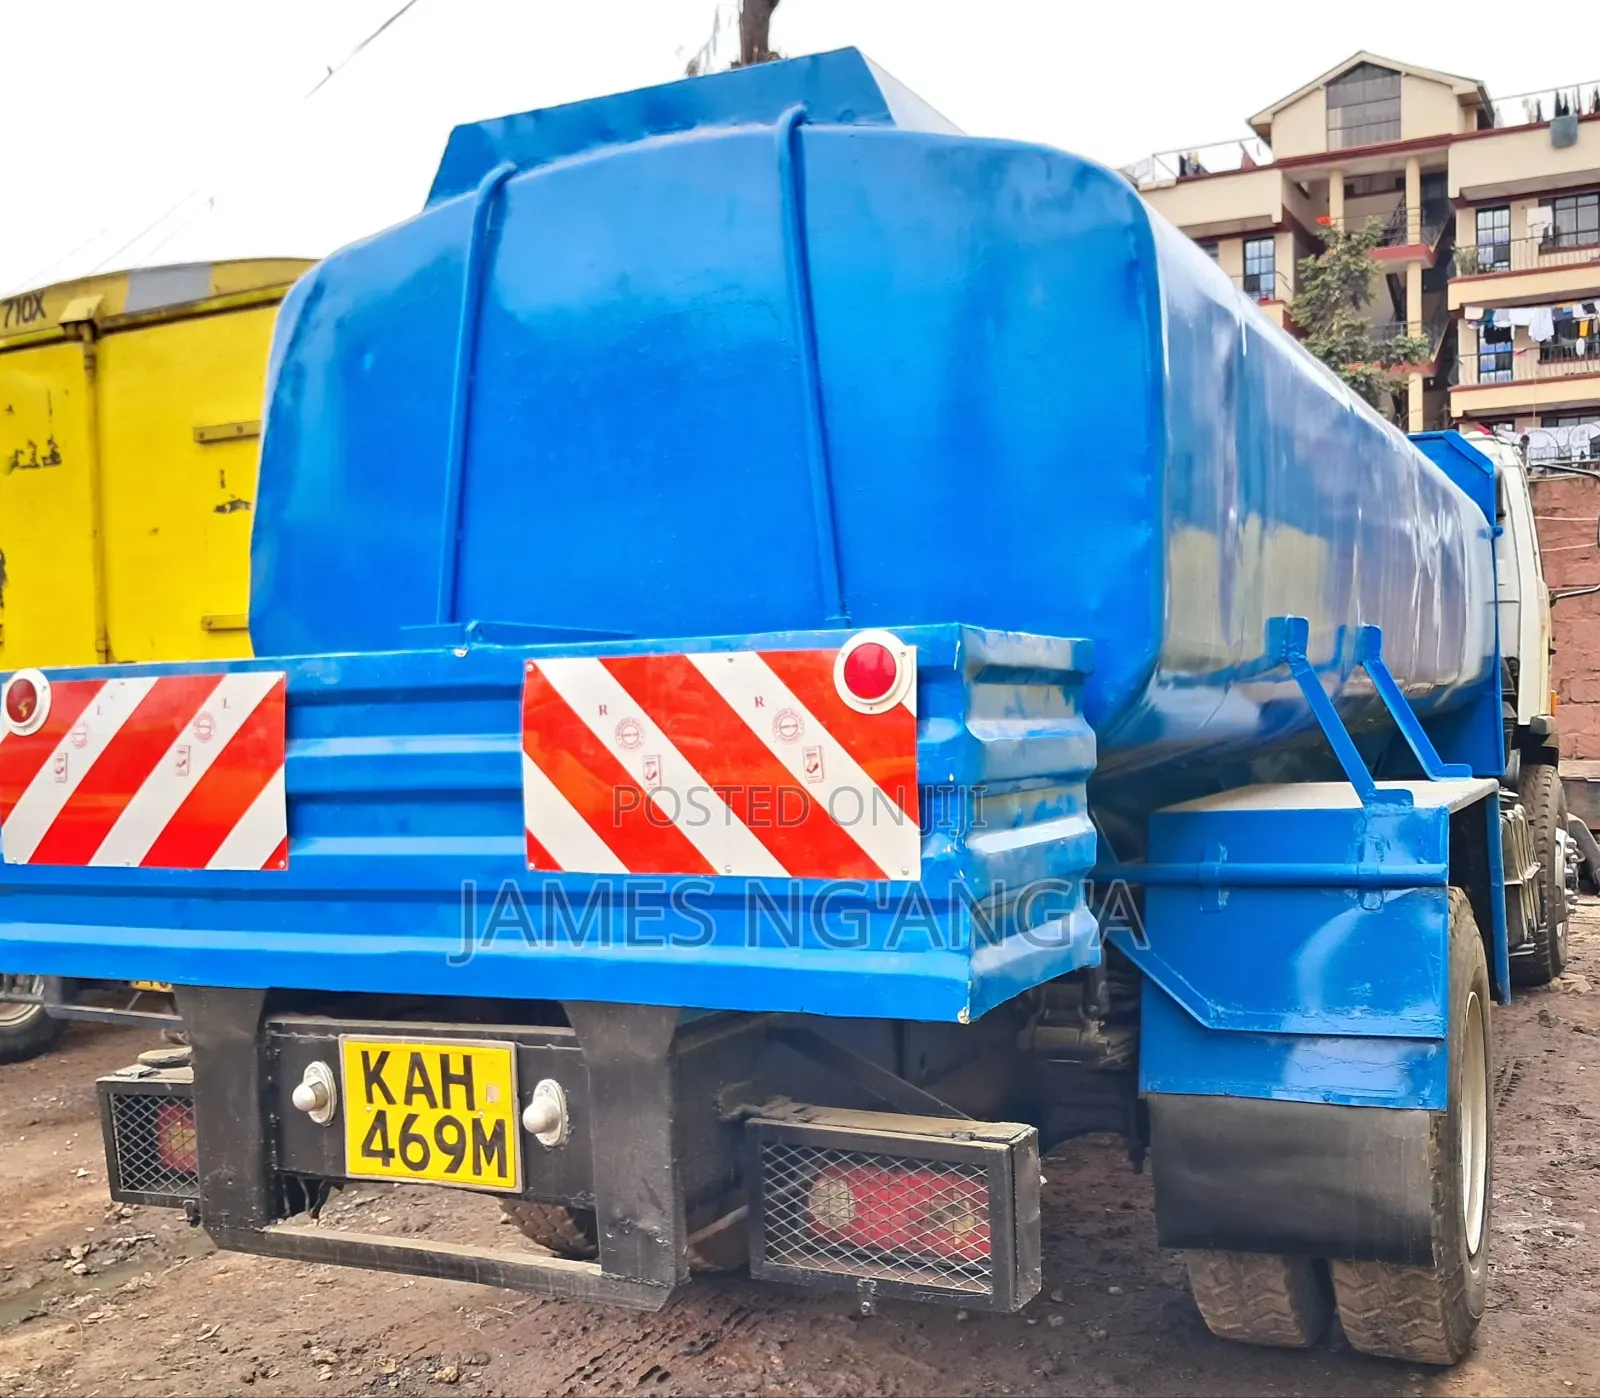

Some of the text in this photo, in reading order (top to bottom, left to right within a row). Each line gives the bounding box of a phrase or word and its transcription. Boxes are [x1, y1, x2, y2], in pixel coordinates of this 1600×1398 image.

[2, 290, 47, 329] 710X
[598, 704, 609, 716] R
[754, 695, 766, 708] R
[361, 1050, 476, 1111] KAH
[361, 1109, 508, 1178] 469M
